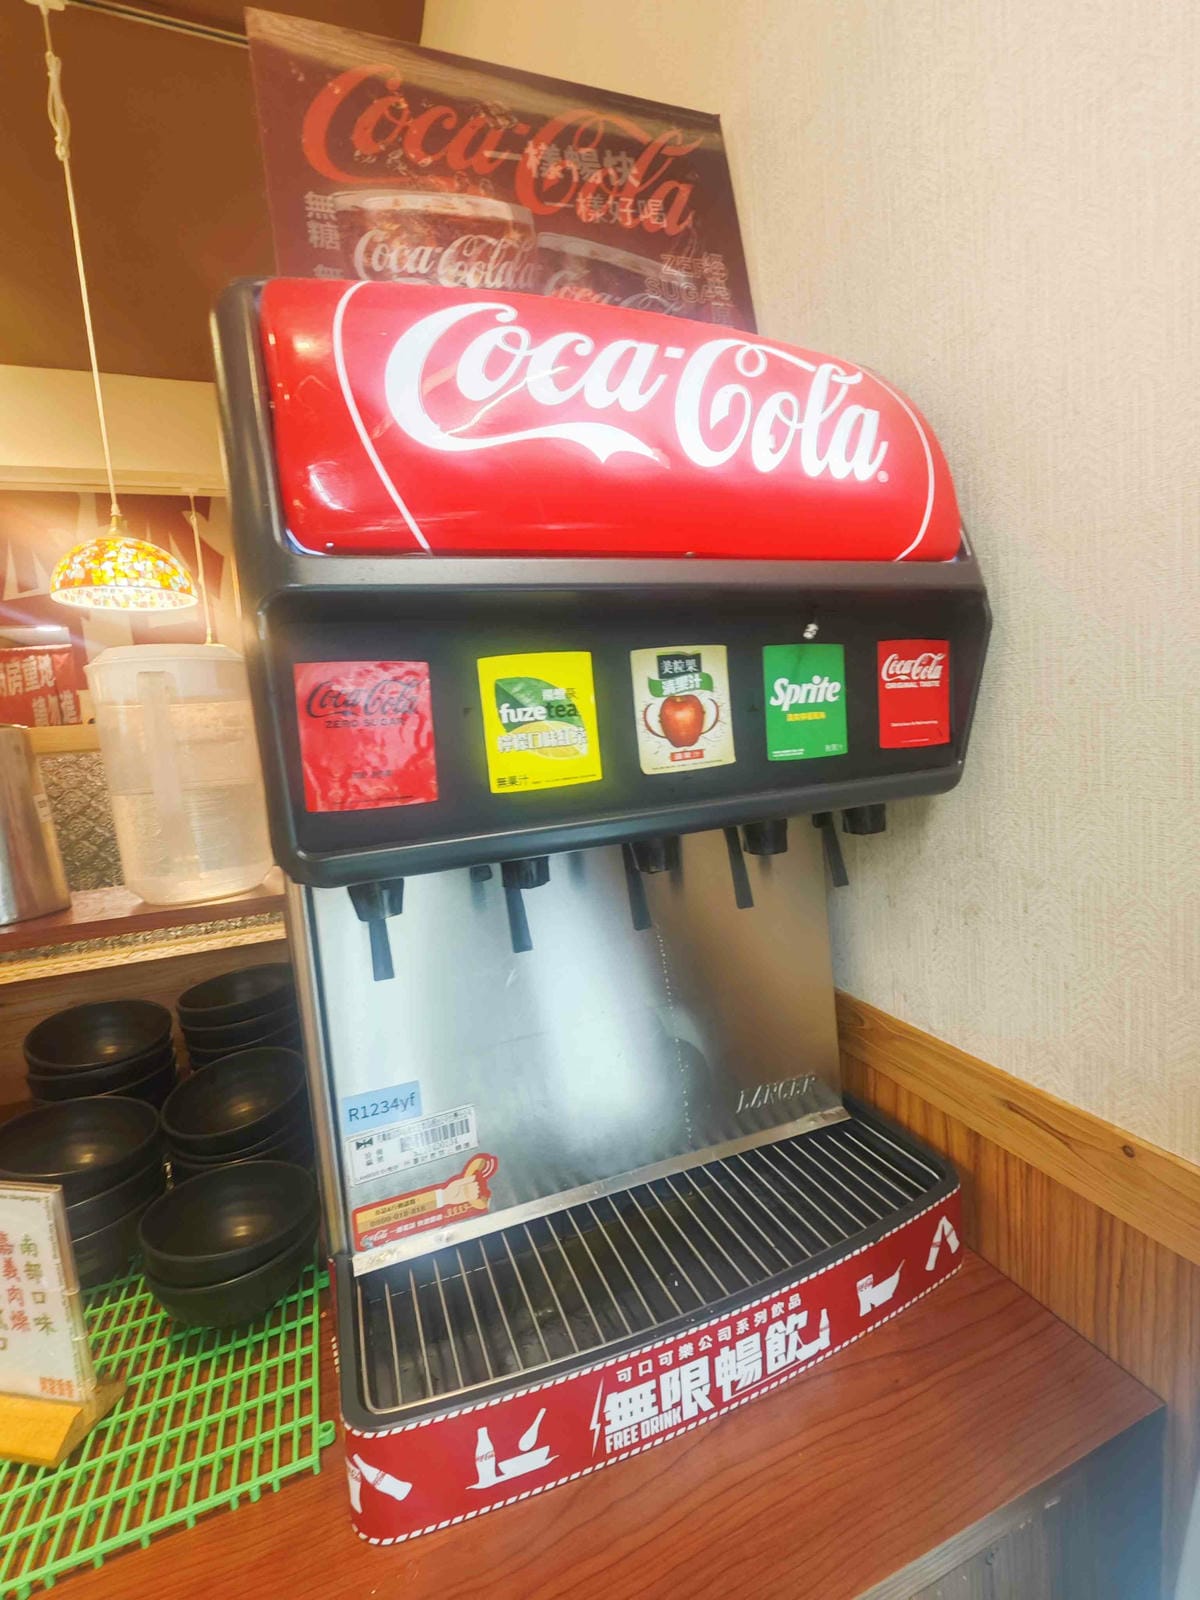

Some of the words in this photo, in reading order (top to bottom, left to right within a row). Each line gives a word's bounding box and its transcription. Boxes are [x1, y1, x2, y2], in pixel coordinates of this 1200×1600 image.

[302, 64, 704, 237] Coca-Cola
[483, 139, 641, 189] 一樣暢快
[304, 191, 341, 251] 無糖
[545, 192, 669, 229] 一樣好喝
[385, 302, 889, 482] Coca-Cola
[769, 674, 841, 712] Sprite
[325, 719, 359, 729] ZERO
[363, 717, 405, 727] SUGAR
[348, 1091, 416, 1122] R1234yf
[616, 1293, 802, 1383] 可口可樂公司系列飲品
[604, 1308, 831, 1435] 無限暢飲
[605, 1426, 639, 1454] FREE
[641, 1405, 684, 1440] DRINK
